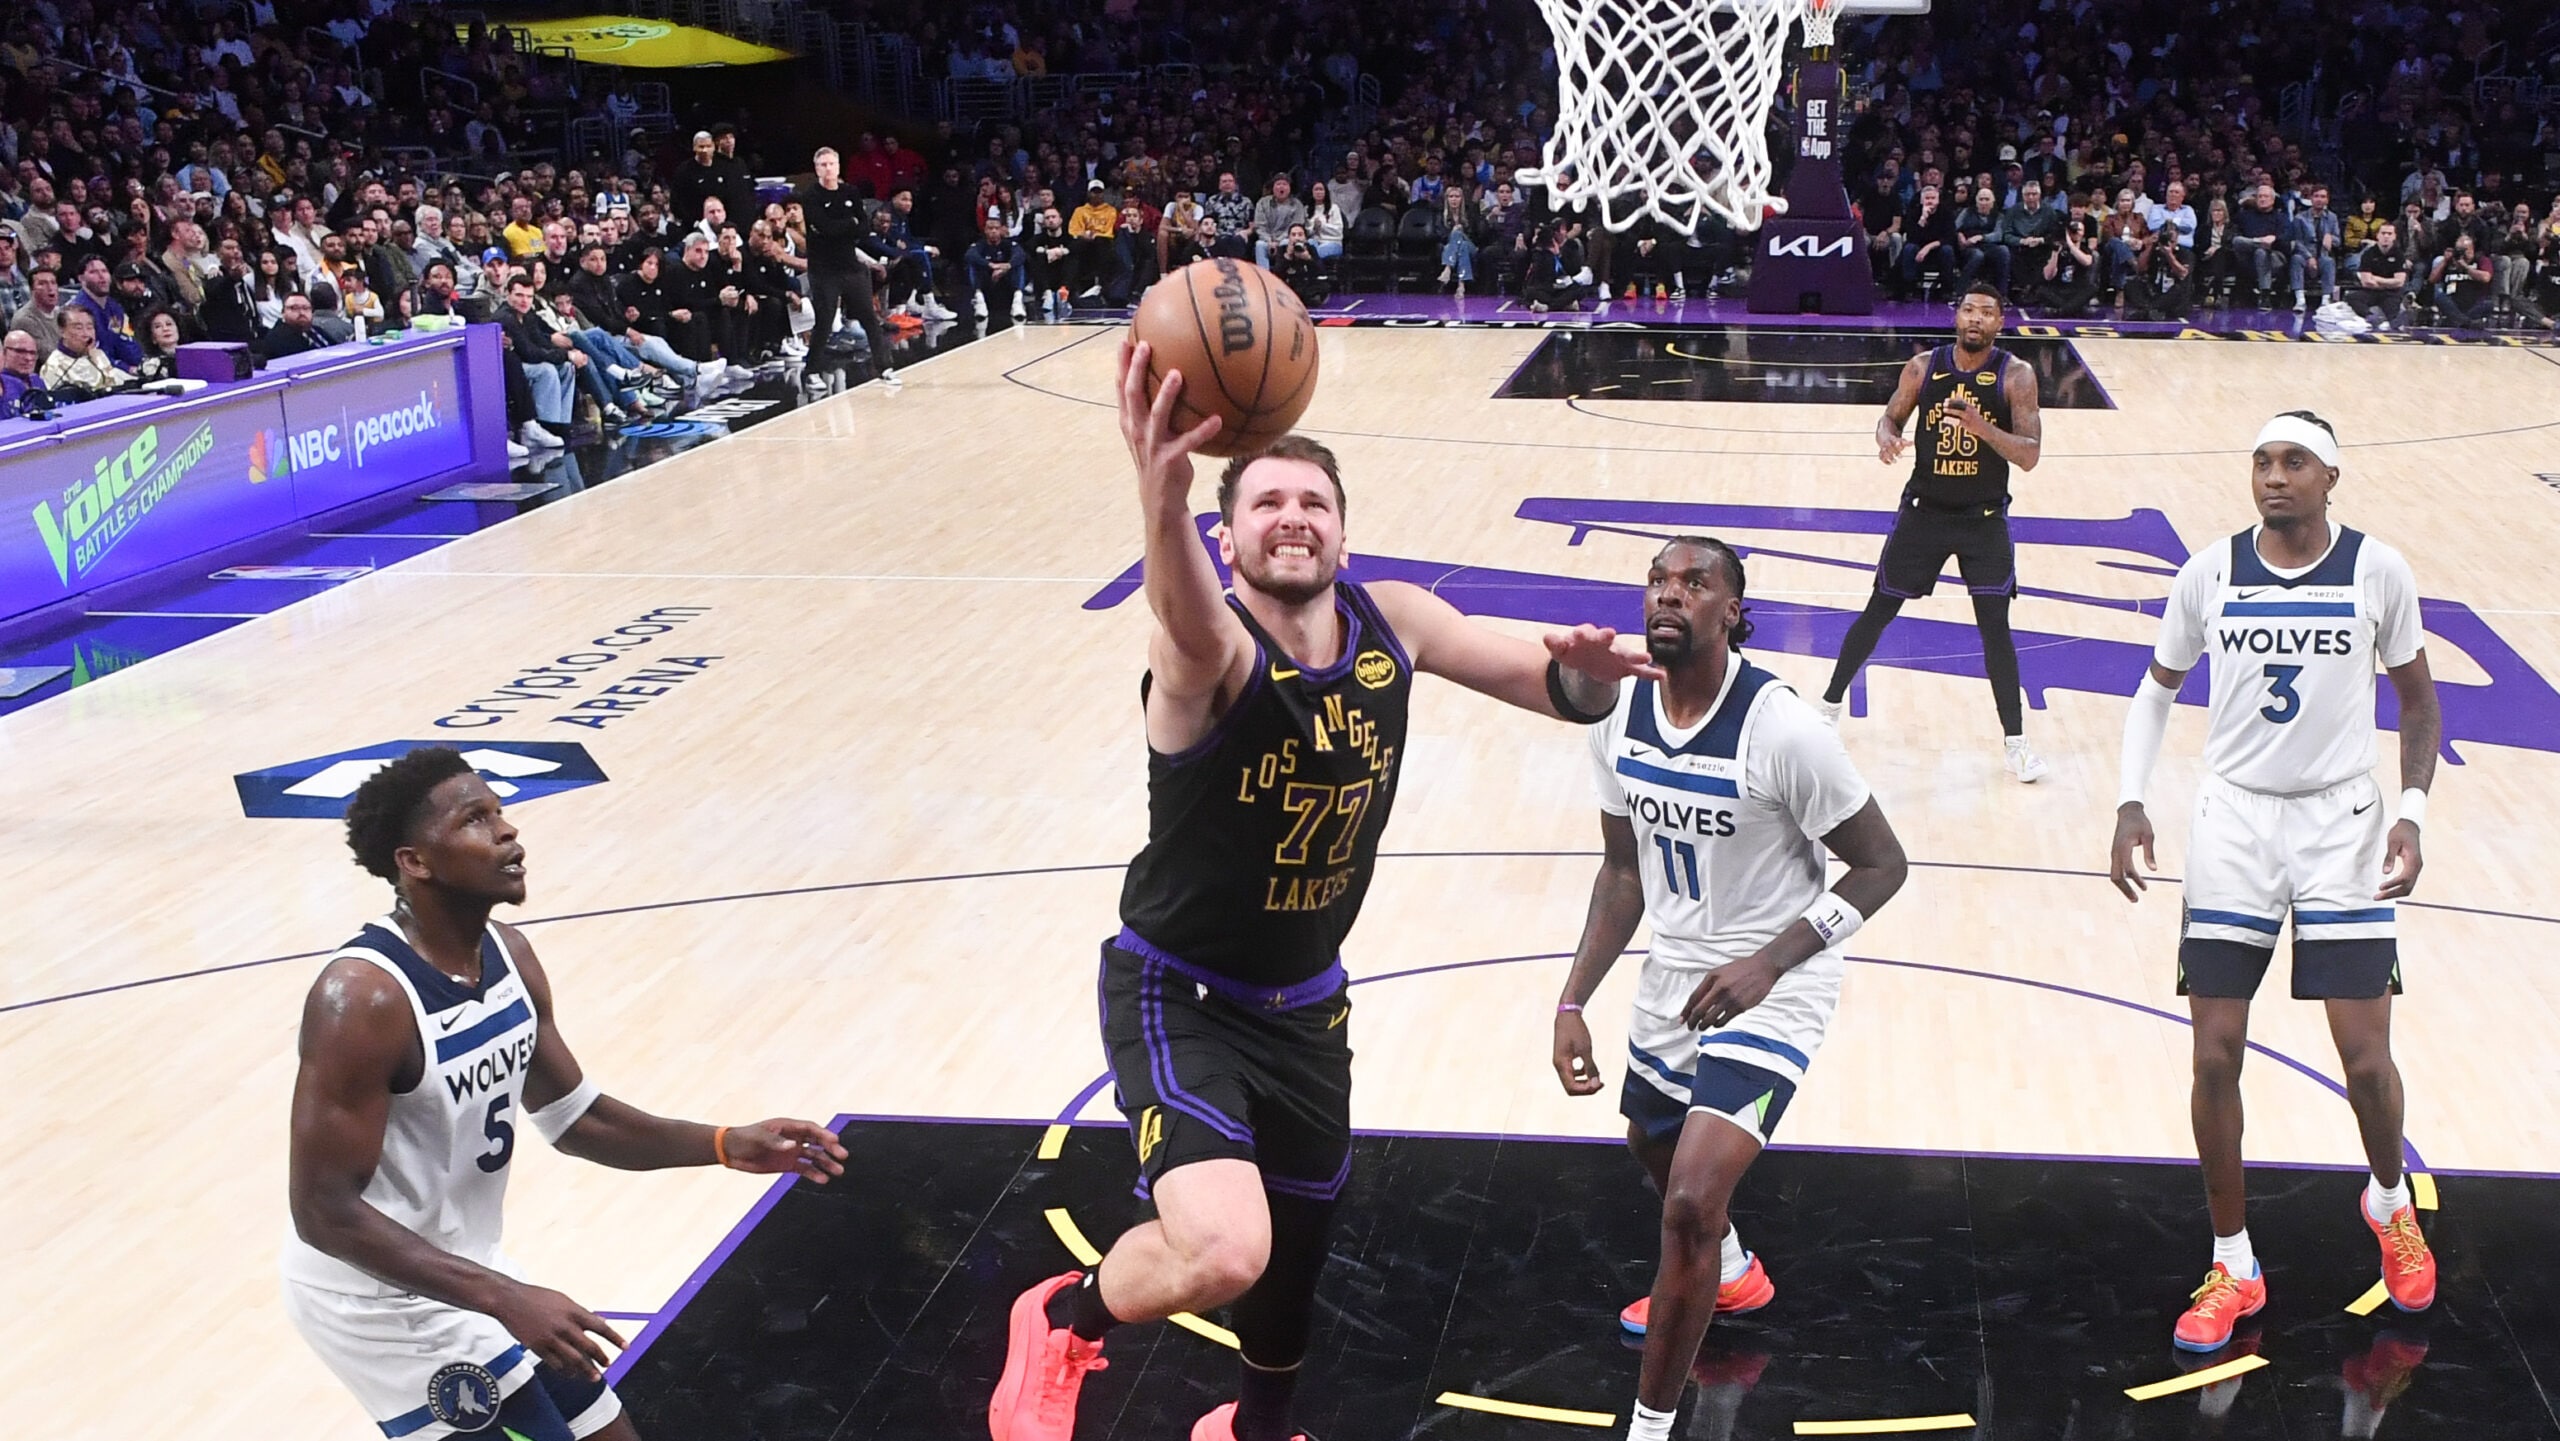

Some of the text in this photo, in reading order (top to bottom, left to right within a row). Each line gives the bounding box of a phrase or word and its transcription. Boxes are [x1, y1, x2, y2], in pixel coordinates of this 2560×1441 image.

[1806, 99, 1827, 118] GET
[1806, 118, 1827, 136] THE
[1810, 137, 1831, 160] App
[1769, 235, 1853, 257] KIA
[1383, 319, 1647, 329] ULTRA
[289, 389, 436, 473] NBC peacock
[1936, 421, 1978, 457] 36
[1933, 458, 1978, 475] LAKERS
[63, 479, 82, 504] the
[75, 425, 214, 573] BATTLE OF CHAMPIONS
[32, 425, 159, 588] Voice
[2219, 628, 2352, 656] WOLVES
[1356, 660, 1392, 677] bibigo
[548, 656, 726, 730] ARENA
[2259, 663, 2304, 725] 3
[1238, 738, 1299, 803] LOS
[1696, 762, 1726, 773] sezzle
[1275, 777, 1374, 866] 77
[1653, 832, 1701, 902] 11
[1826, 908, 1844, 928] 11
[476, 1091, 515, 1174] 5
